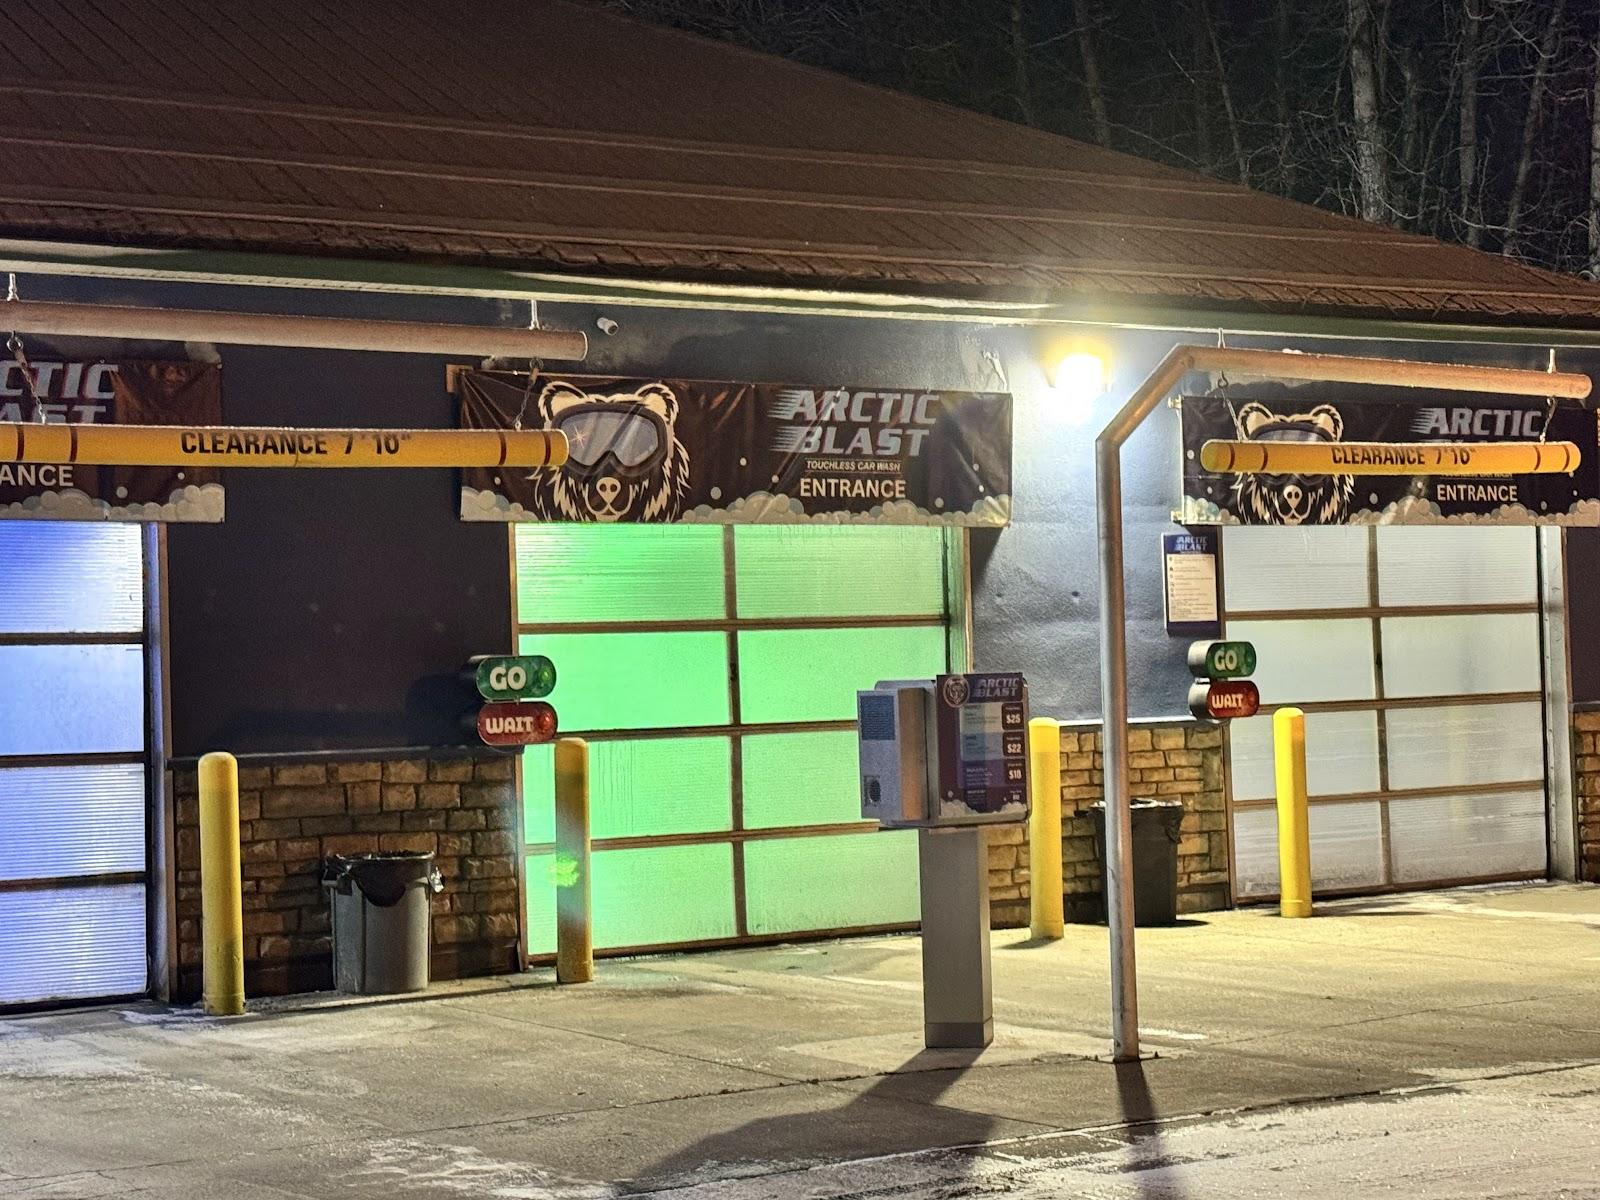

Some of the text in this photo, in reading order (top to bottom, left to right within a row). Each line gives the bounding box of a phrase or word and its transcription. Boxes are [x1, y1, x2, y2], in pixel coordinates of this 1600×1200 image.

[769, 390, 939, 424] ARCTIC
[1410, 407, 1542, 437] ARCTIC
[180, 431, 328, 455] CLEARANCE
[770, 425, 930, 457] BLAST
[1331, 447, 1425, 465] CLEARANCE
[807, 460, 901, 471] TOUCHLESS CAR WASH
[800, 478, 906, 498] ENTRANCE
[1437, 484, 1518, 502] ENTRANCE
[1214, 650, 1237, 671] GO
[489, 666, 526, 690] GO
[977, 677, 1019, 688] ARCTIC
[974, 687, 1017, 698] BLAST
[1212, 694, 1243, 709] WAIT
[485, 716, 533, 734] WAIT
[1006, 713, 1021, 724] $25
[1007, 743, 1022, 754] $22
